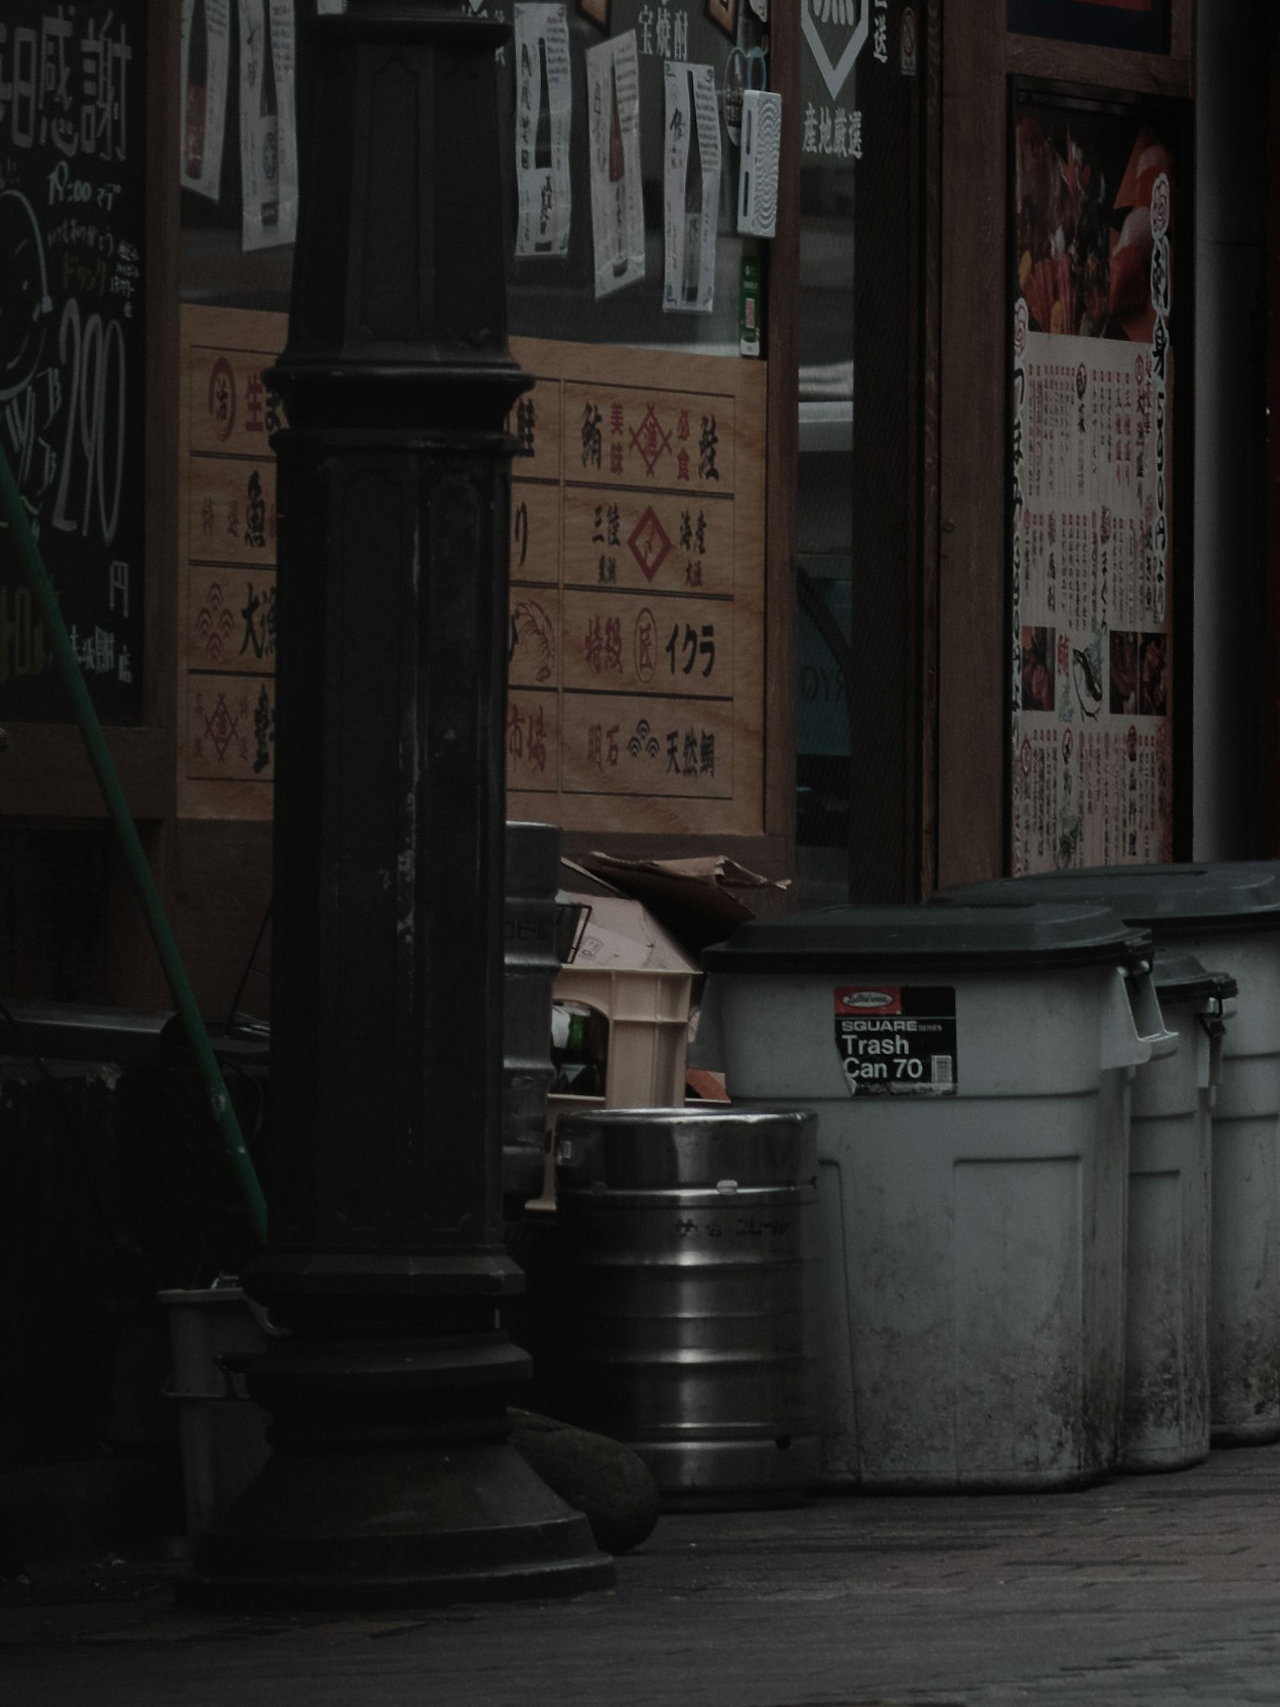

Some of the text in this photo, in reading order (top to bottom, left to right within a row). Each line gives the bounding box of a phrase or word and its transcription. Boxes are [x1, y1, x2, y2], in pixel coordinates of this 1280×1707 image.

[52, 296, 127, 547] 290
[664, 621, 716, 678] イクラ
[841, 1020, 918, 1033] SQUARE
[841, 1033, 910, 1057] Trash
[842, 1057, 924, 1080] Can 70
